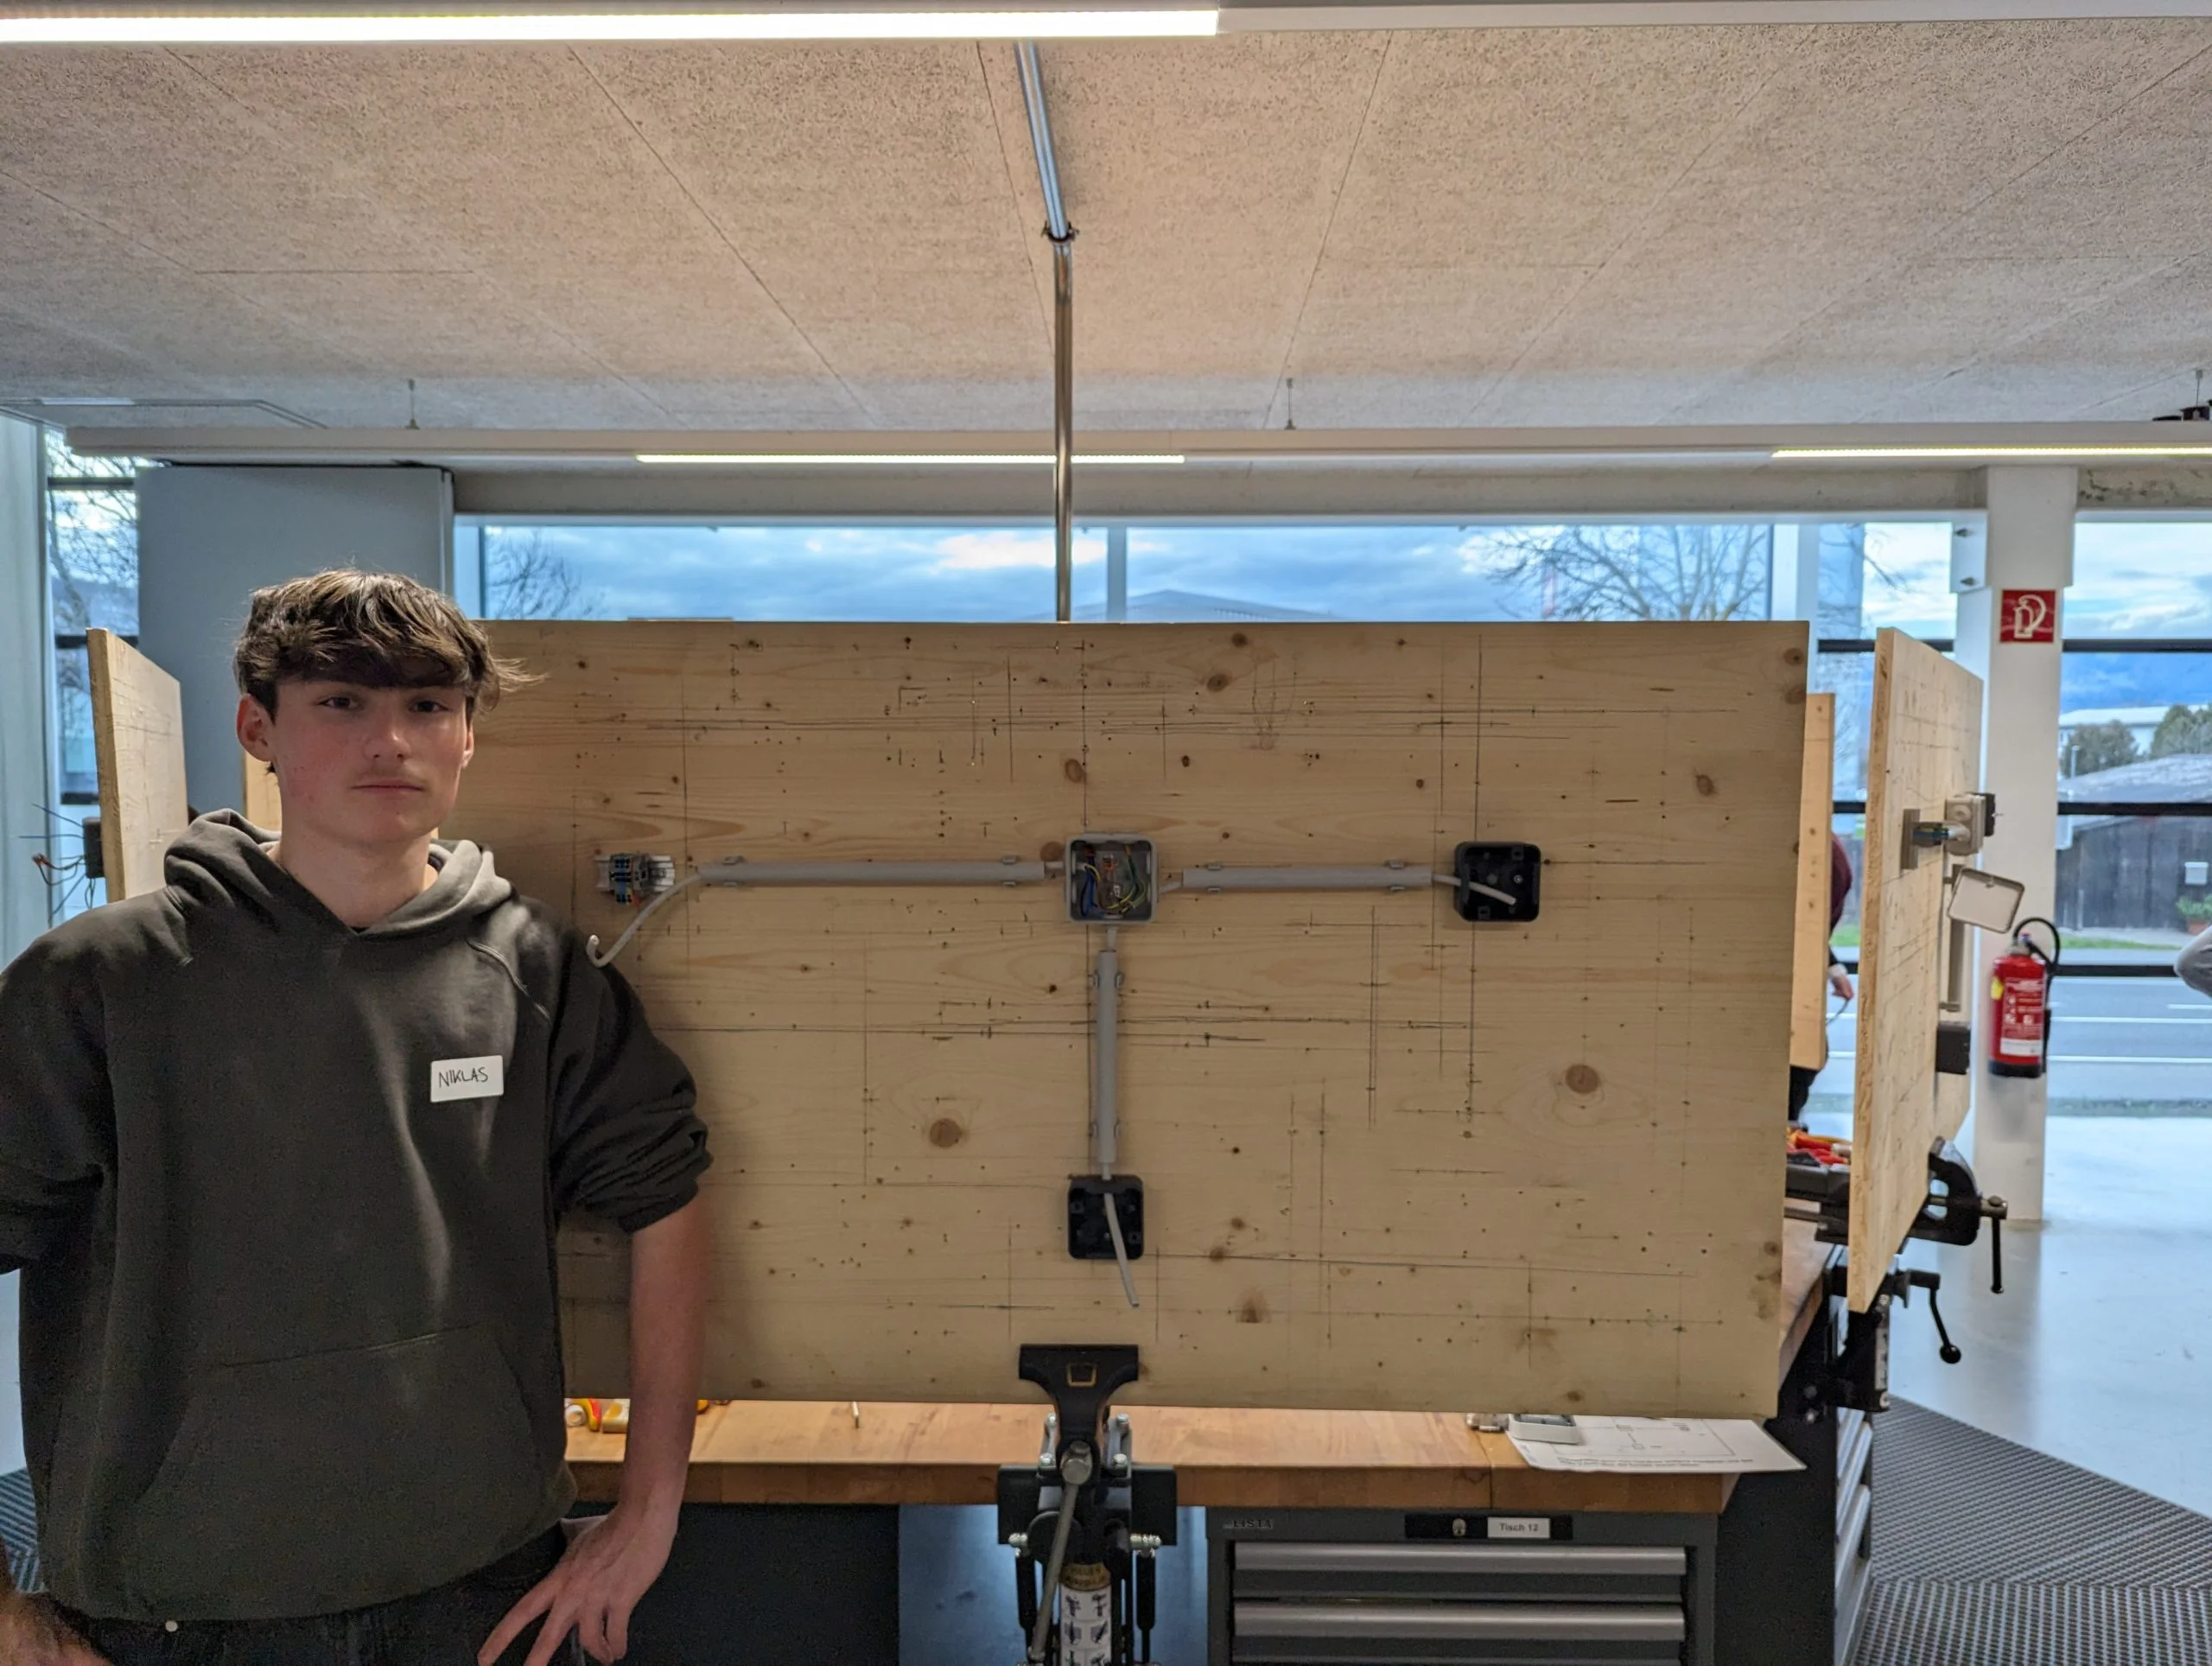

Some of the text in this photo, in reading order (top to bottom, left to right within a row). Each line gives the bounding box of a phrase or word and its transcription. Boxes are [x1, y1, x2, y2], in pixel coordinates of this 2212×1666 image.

[438, 1066, 489, 1088] NIKLAS
[1499, 1523, 1539, 1532] Tisch 12
